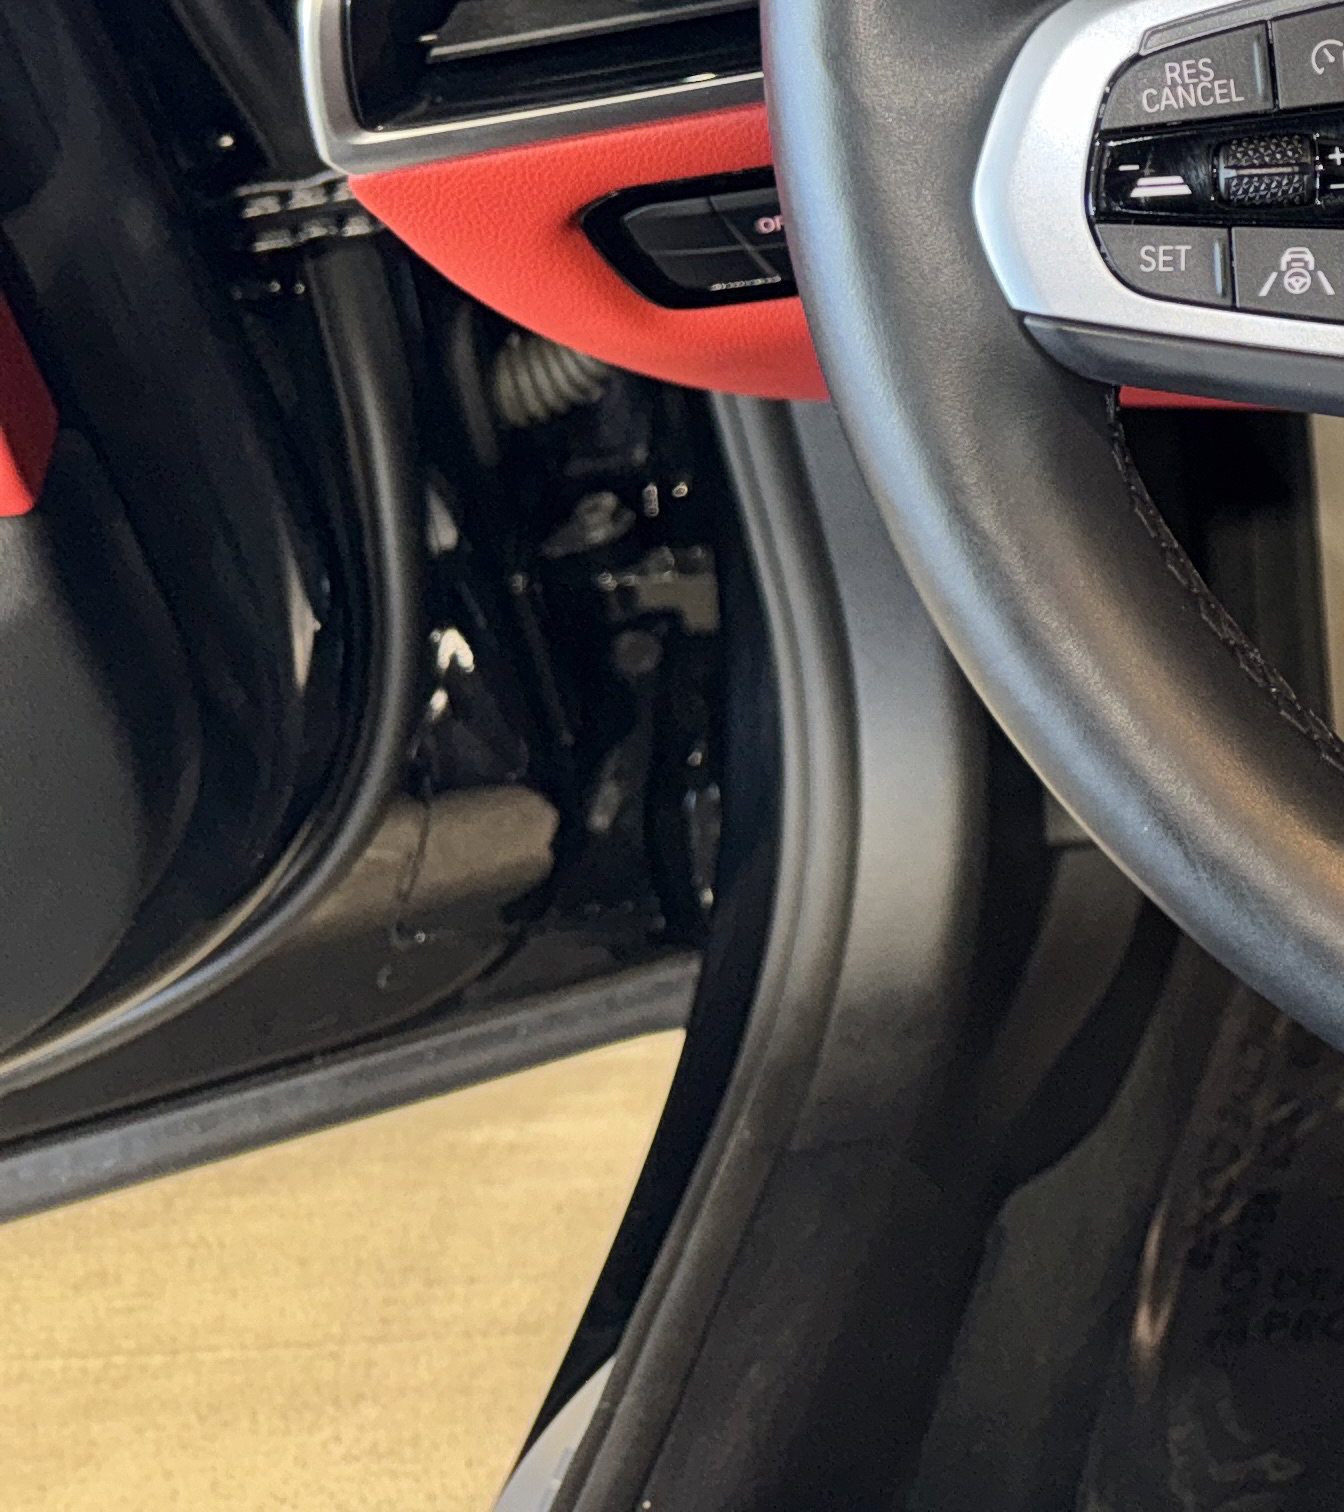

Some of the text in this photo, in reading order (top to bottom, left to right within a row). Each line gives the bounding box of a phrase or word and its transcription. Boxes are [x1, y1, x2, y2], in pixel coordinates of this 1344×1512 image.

[1165, 58, 1216, 87] RES
[1141, 79, 1245, 111] CANCEL
[1139, 245, 1192, 273] SET
